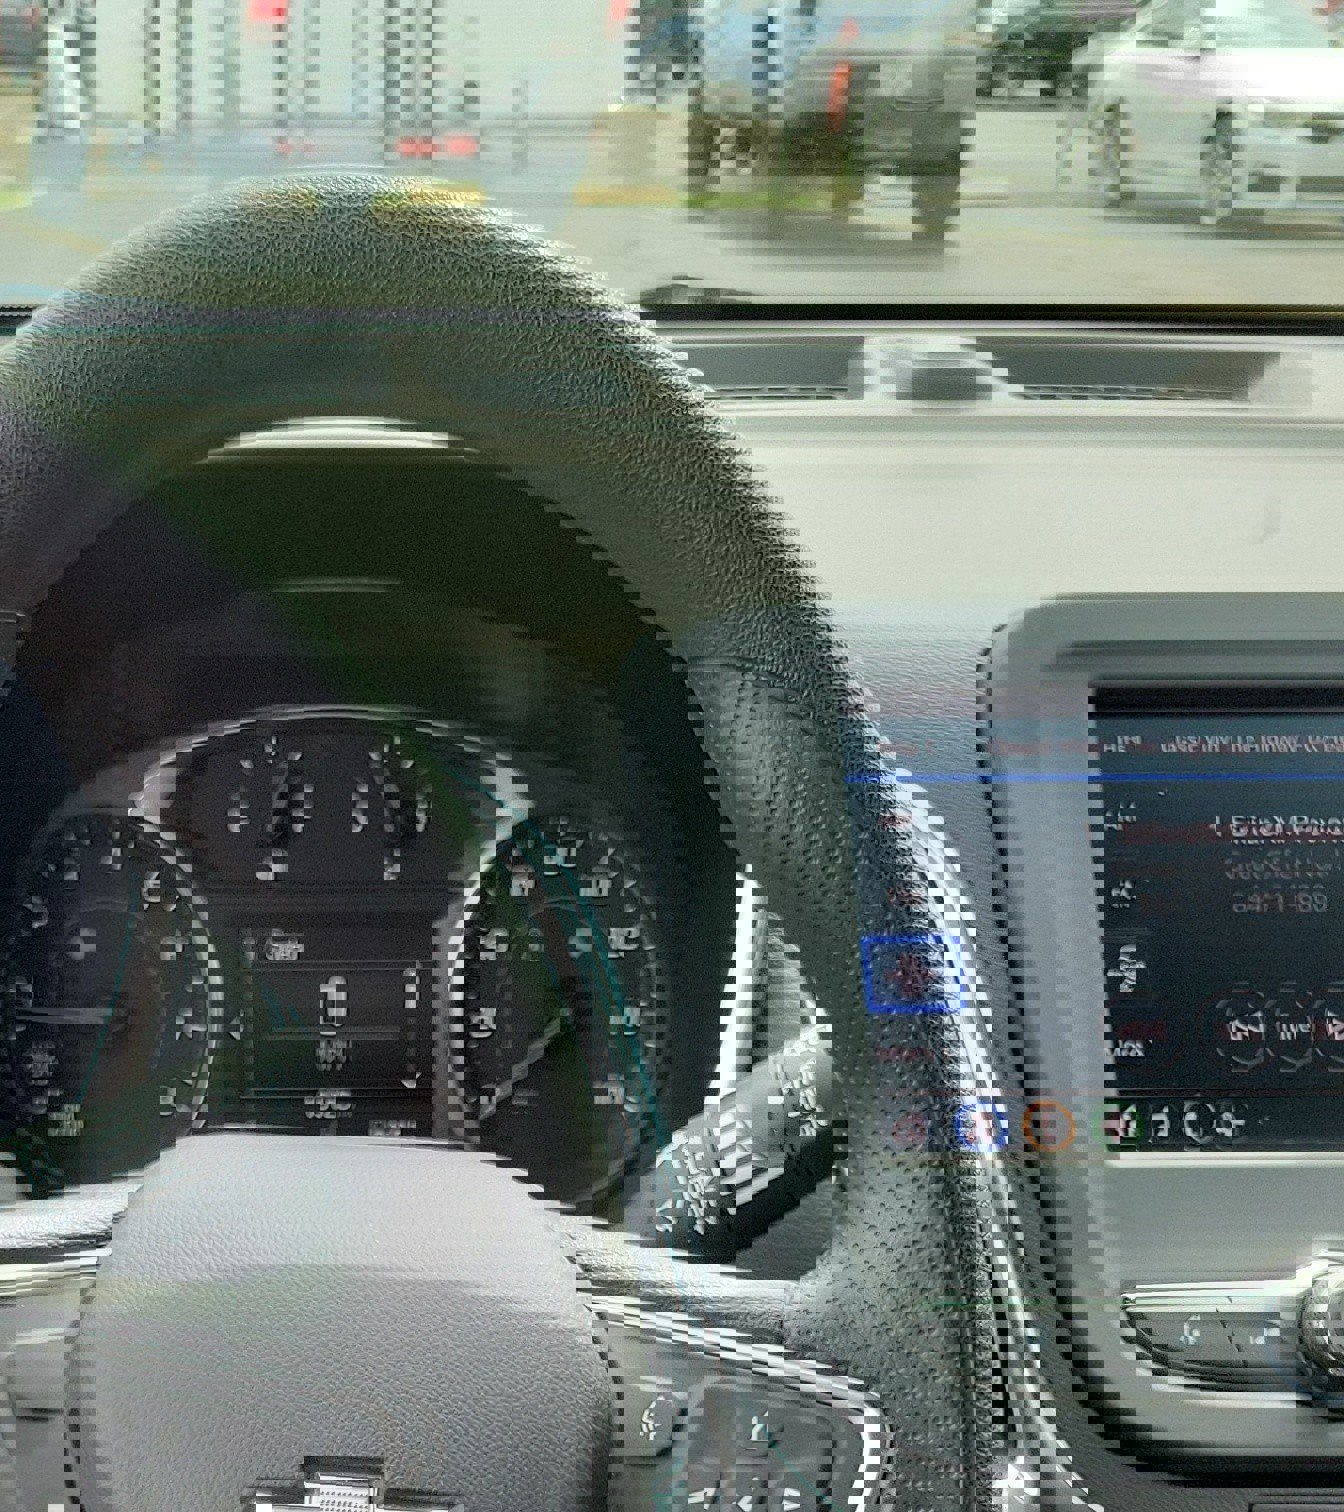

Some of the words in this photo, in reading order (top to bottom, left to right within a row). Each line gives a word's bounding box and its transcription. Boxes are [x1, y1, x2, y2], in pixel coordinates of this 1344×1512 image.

[876, 737, 919, 758] Hits
[984, 736, 1056, 758] Classic
[1058, 736, 1108, 761] Vinyl
[1119, 736, 1160, 757] The
[1164, 735, 1252, 760] Highway
[1258, 735, 1304, 755] FOX
[877, 811, 916, 832] AM
[1080, 818, 1095, 846] 1
[1117, 818, 1238, 846] SiriusXM
[1112, 856, 1181, 881] Great
[1187, 856, 1254, 880] Offer
[1262, 856, 1326, 880] Now!
[886, 886, 923, 909] FM
[1135, 891, 1312, 916] 844-711-8800
[1211, 1021, 1264, 1043] Tune
[878, 1043, 937, 1065] More
[248, 1060, 286, 1094] OFF
[254, 1086, 291, 1119] INT
[265, 1112, 301, 1142] ON
[36, 1171, 70, 1204] INT
[44, 1193, 79, 1224] OFF
